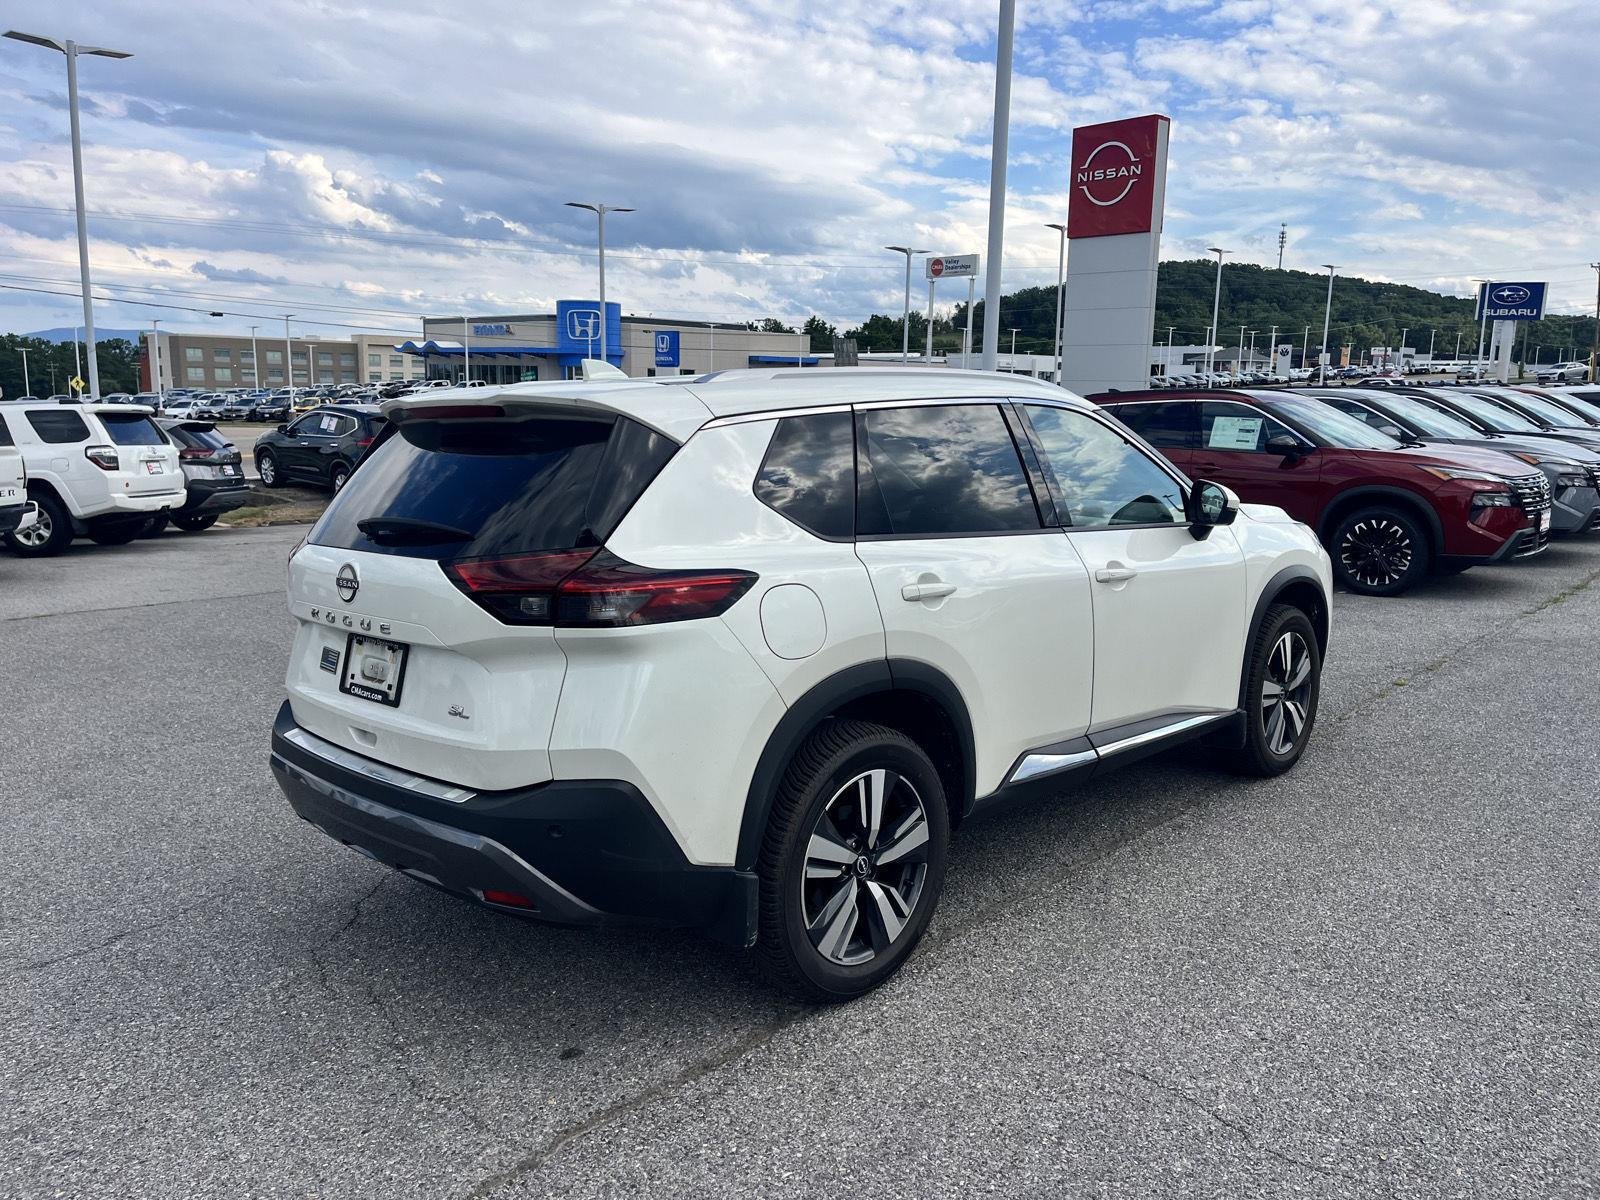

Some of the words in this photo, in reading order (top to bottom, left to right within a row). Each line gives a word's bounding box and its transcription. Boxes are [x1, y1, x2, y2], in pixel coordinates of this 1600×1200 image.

[1077, 164, 1142, 183] NISSAN
[1482, 308, 1537, 316] SUBARU
[336, 577, 359, 588] SSAN
[310, 606, 391, 635] ROGUE
[350, 685, 384, 702] CMAcars.com
[447, 704, 470, 720] SL
